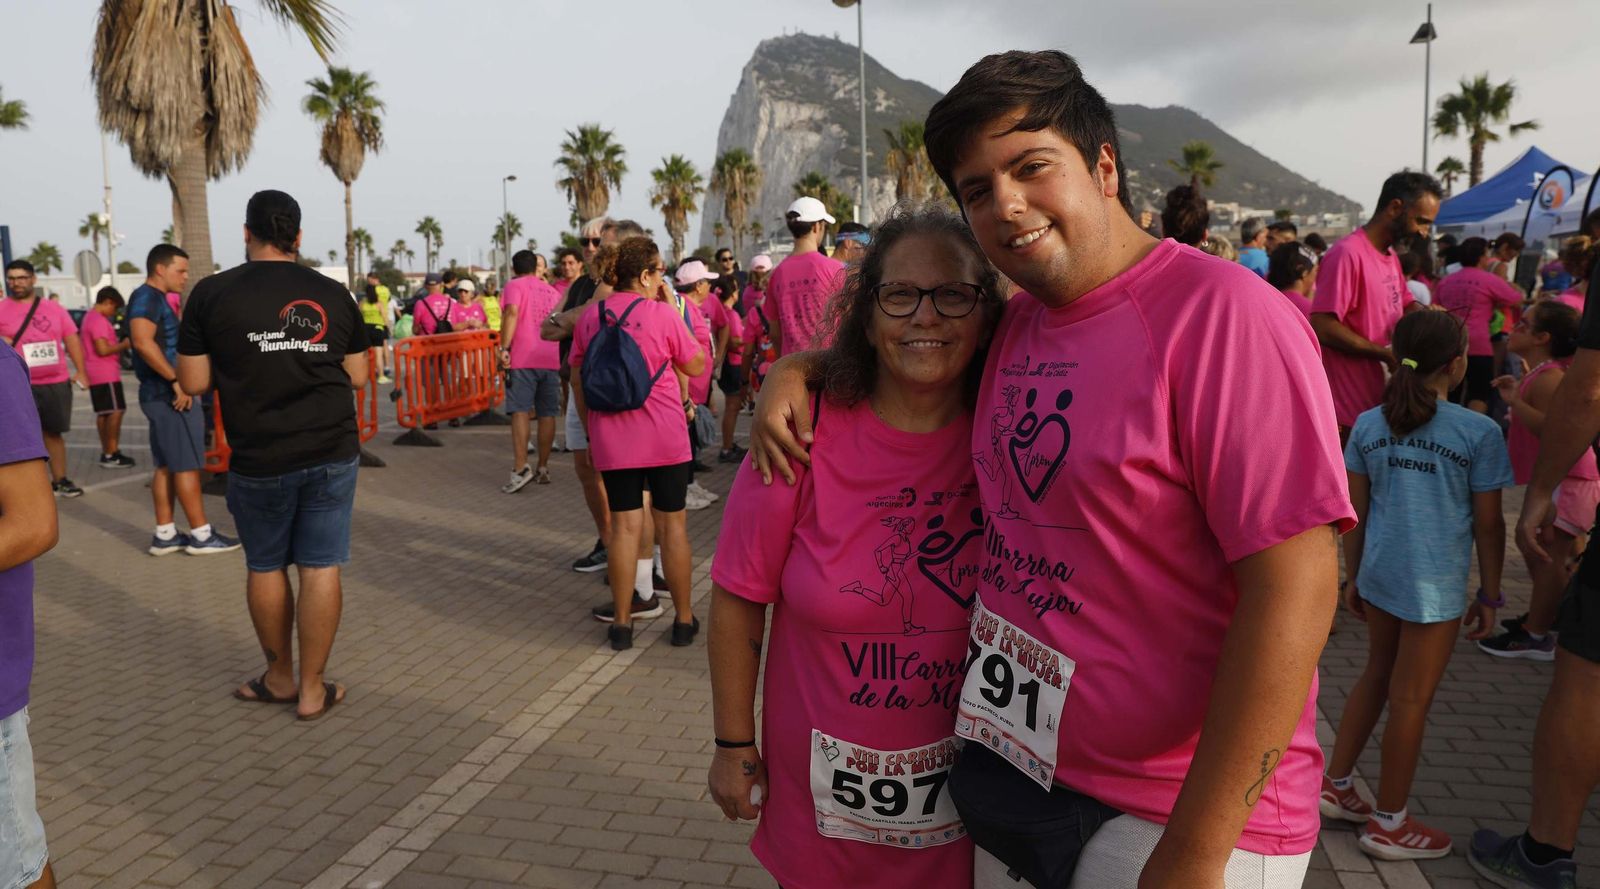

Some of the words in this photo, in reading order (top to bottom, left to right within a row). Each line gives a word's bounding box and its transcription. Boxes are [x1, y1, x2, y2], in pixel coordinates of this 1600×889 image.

[247, 331, 285, 342] Turismo
[259, 338, 310, 352] Running
[31, 348, 55, 358] 458
[1362, 437, 1387, 455] CLUB
[1389, 437, 1404, 446] DE
[1407, 437, 1469, 468] ATLETISMO
[1003, 625, 1060, 673] CARRERA
[999, 636, 1013, 658] LA
[1017, 648, 1062, 690] MUJER
[850, 683, 881, 708] de
[884, 685, 914, 710] la
[846, 756, 879, 776] POR
[884, 763, 906, 776] LA
[885, 739, 957, 766] CARRERA
[831, 769, 949, 817] 597
